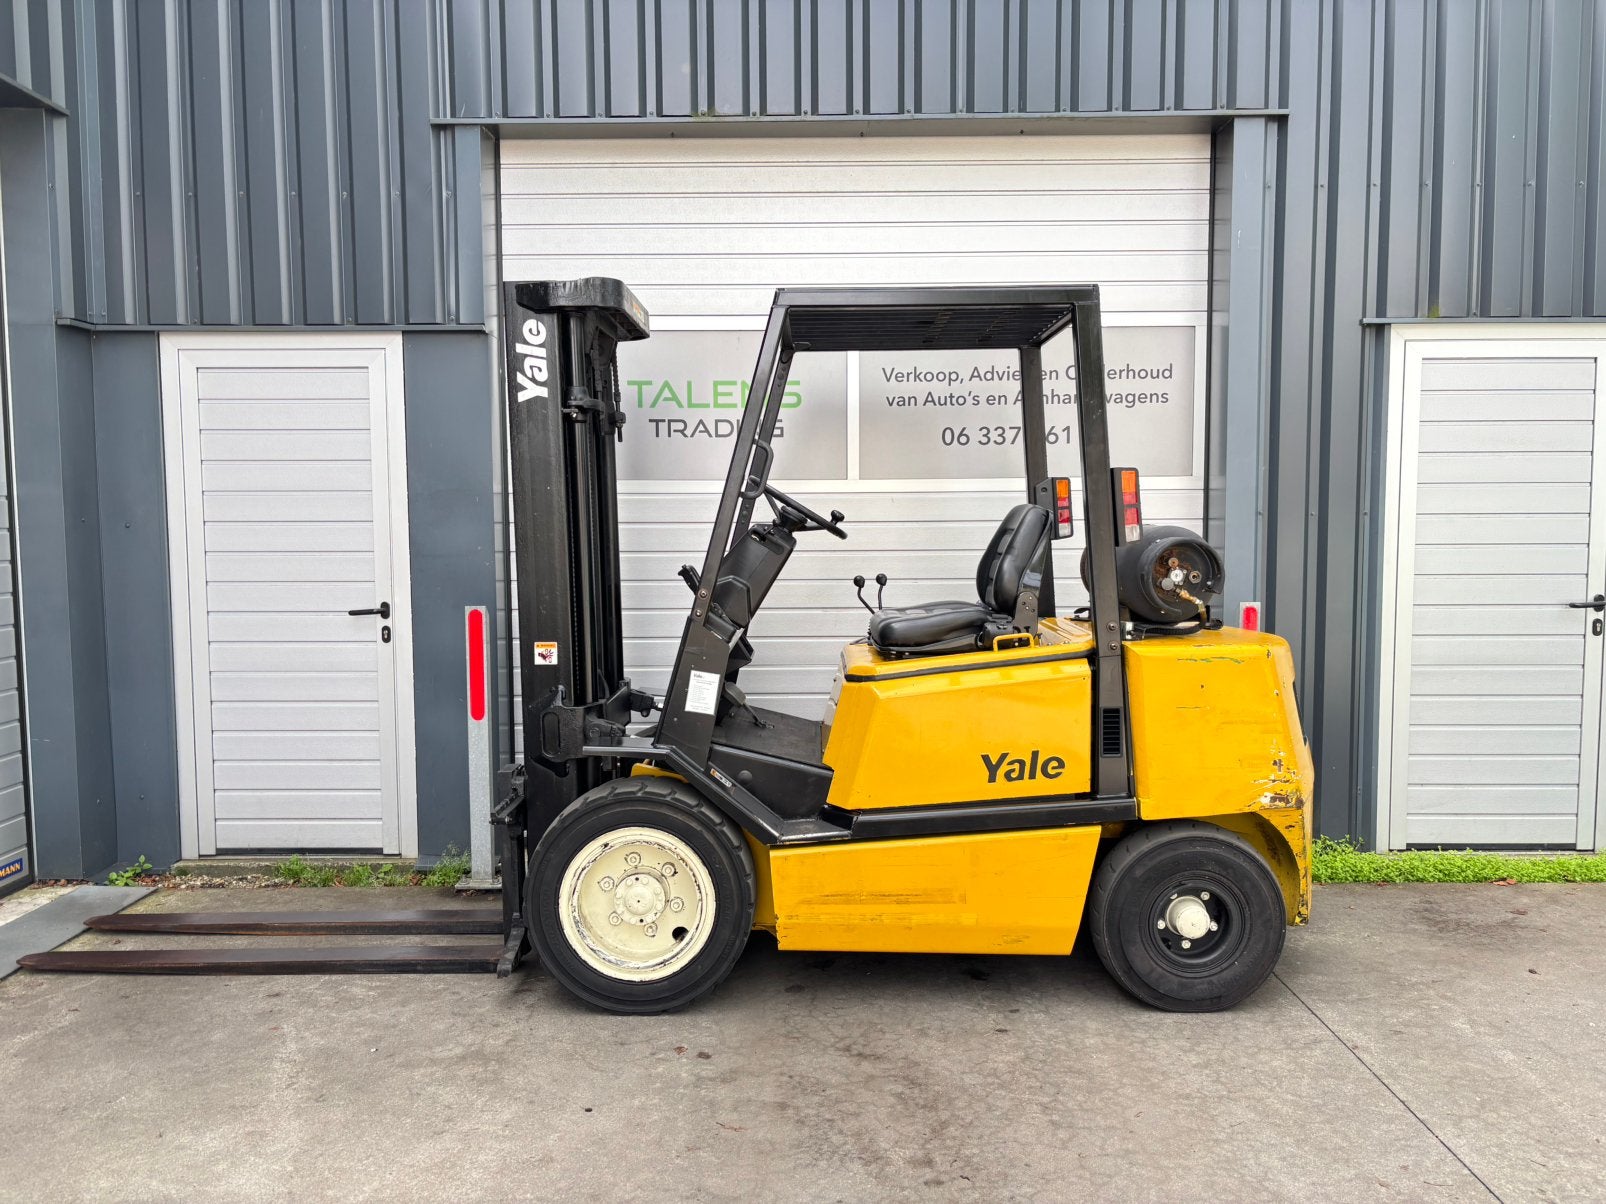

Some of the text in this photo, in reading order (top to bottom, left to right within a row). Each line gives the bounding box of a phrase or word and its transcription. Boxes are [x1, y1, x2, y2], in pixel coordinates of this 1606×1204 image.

[515, 318, 549, 403] Yale
[881, 366, 964, 387] Verkoop,
[969, 365, 1021, 383] Advie
[1065, 362, 1173, 381] Oerhoud
[885, 395, 918, 407] van
[985, 393, 1008, 407] en
[941, 426, 970, 446] 06
[980, 749, 1066, 784] Yale
